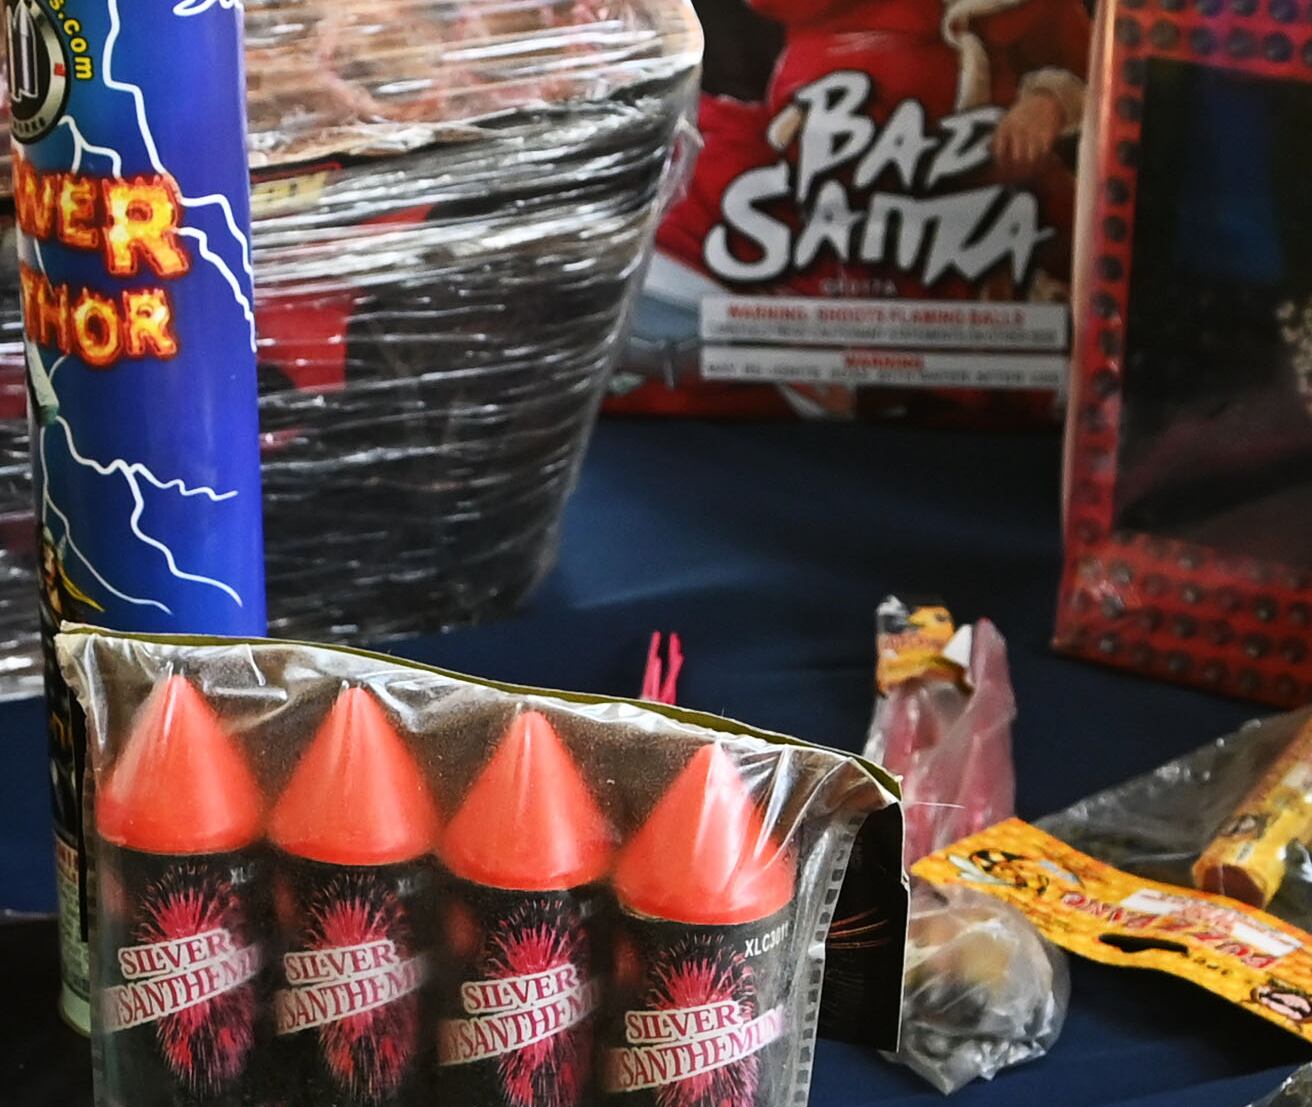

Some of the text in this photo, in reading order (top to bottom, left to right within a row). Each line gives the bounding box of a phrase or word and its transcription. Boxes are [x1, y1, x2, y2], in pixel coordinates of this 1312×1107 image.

[704, 164, 1056, 287] SANTA
[120, 931, 230, 976] SILVER
[286, 943, 397, 982] SILVER
[463, 967, 577, 1012] SILVER
[627, 1004, 739, 1042] SILVER
